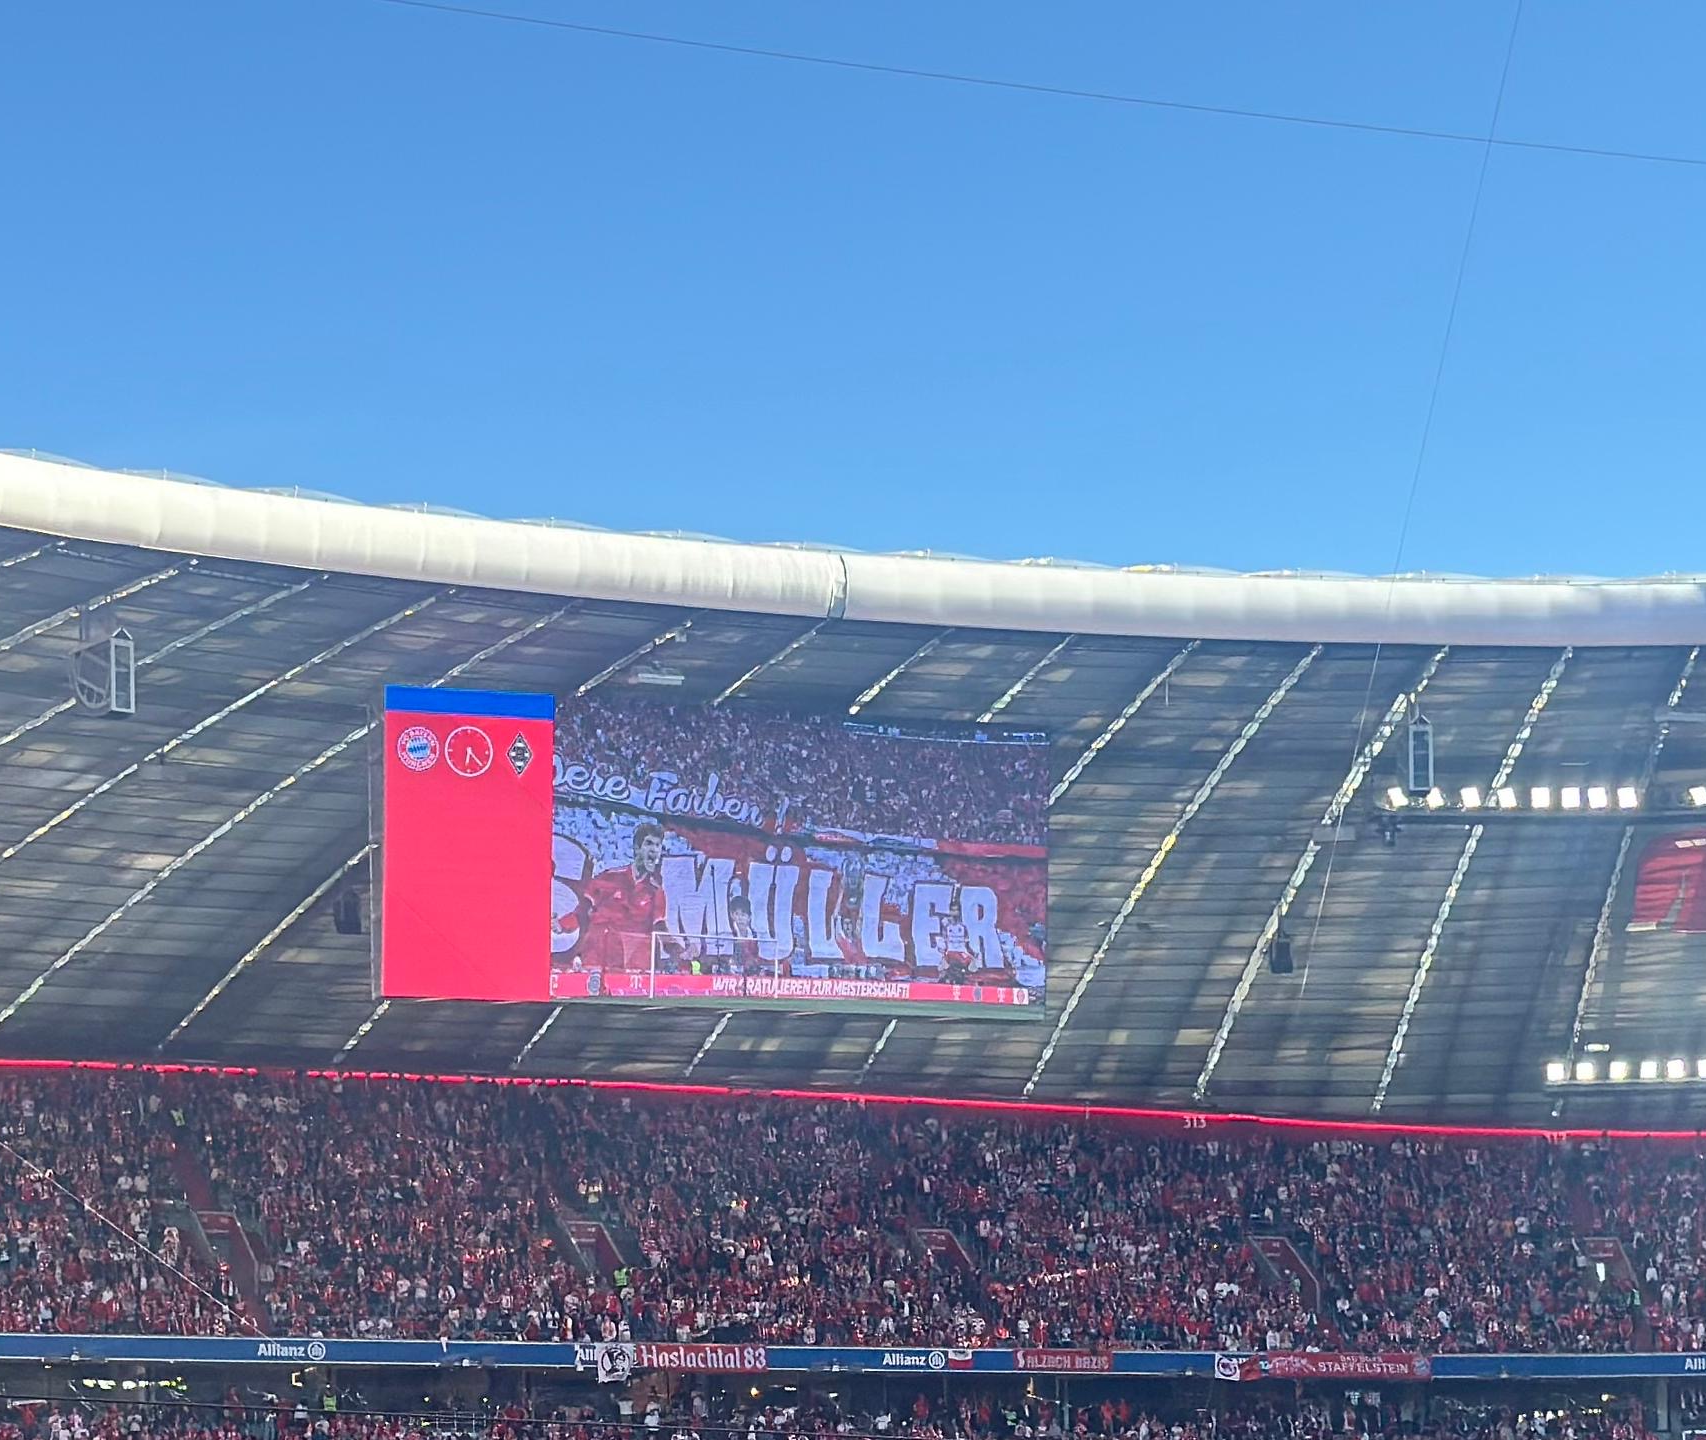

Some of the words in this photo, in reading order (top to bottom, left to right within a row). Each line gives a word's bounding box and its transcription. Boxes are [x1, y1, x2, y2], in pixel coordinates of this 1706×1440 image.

[646, 771, 765, 829] Farben
[662, 844, 1001, 970] MÜLLER
[257, 1342, 305, 1358] Allianz
[640, 1345, 741, 1370] Haslachtal
[744, 1347, 767, 1367] 83
[883, 1353, 926, 1367] Allianz
